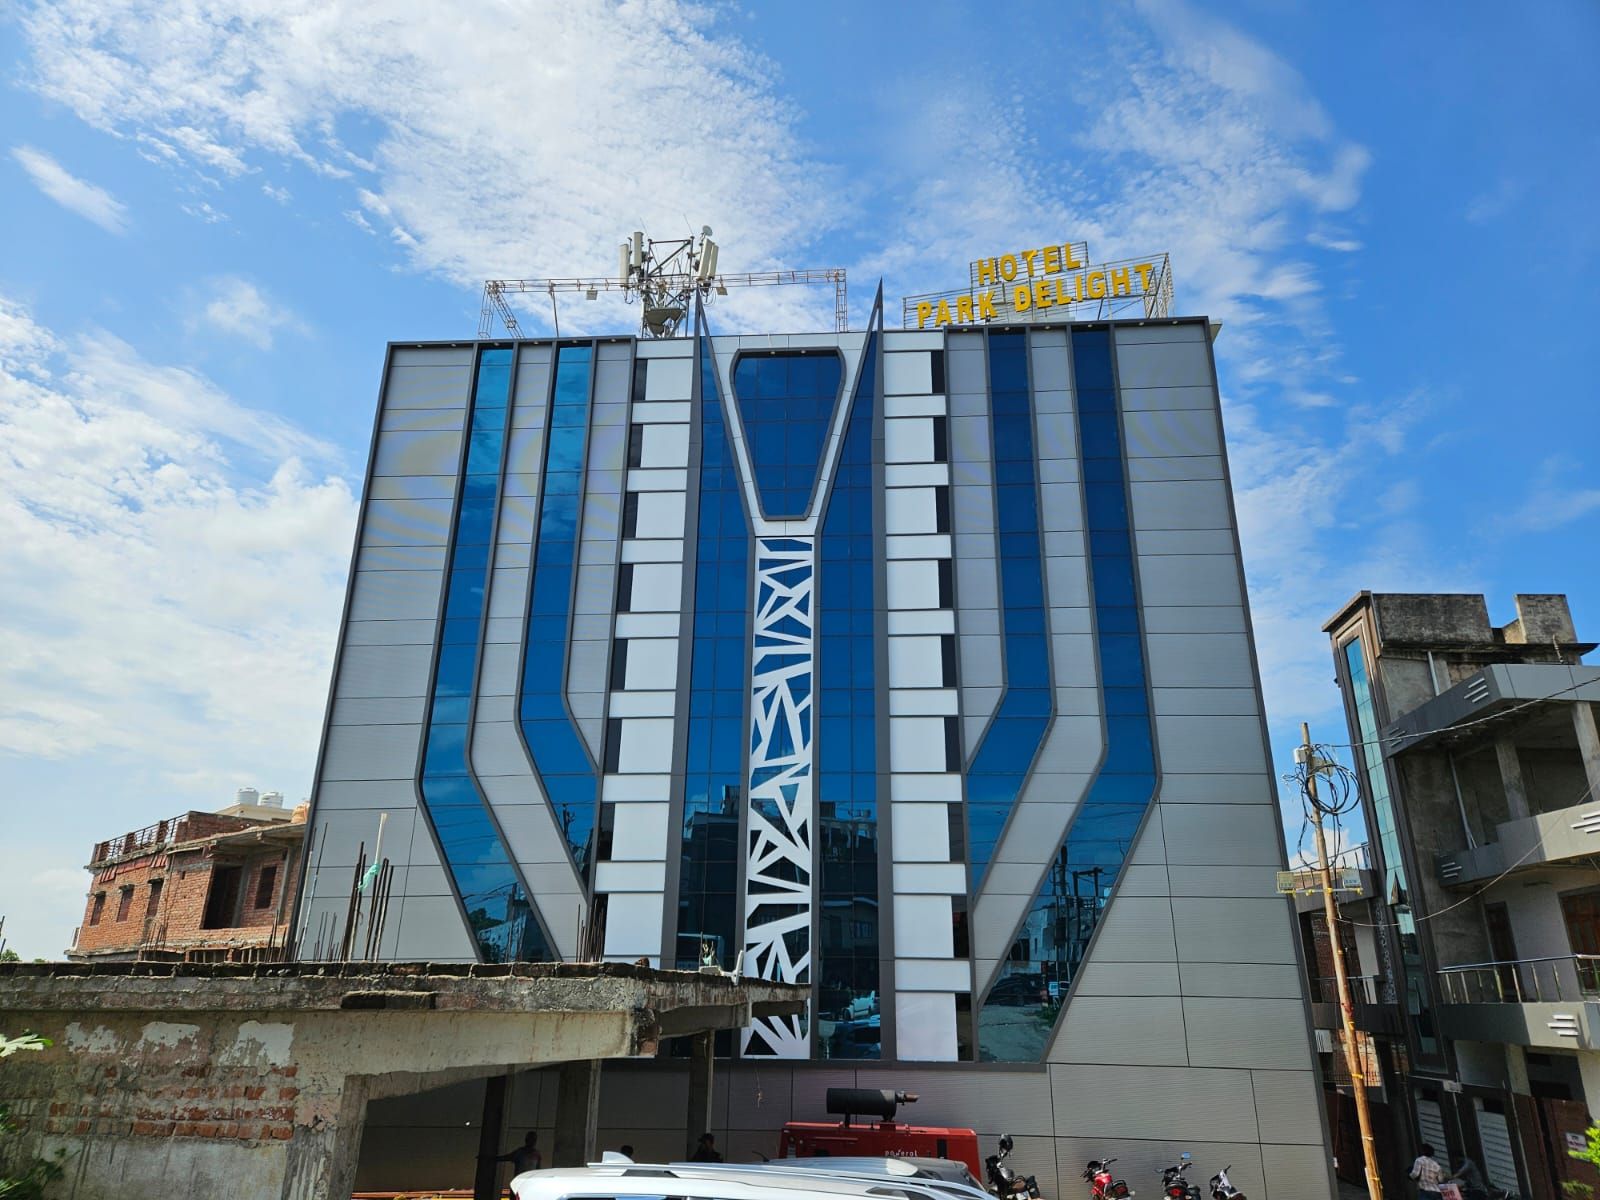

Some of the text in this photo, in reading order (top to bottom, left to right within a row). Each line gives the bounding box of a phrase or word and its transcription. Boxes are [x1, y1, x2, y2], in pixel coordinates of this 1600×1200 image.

[977, 242, 1081, 285] HOTEL
[916, 263, 1152, 329] PARK DELIGHT
